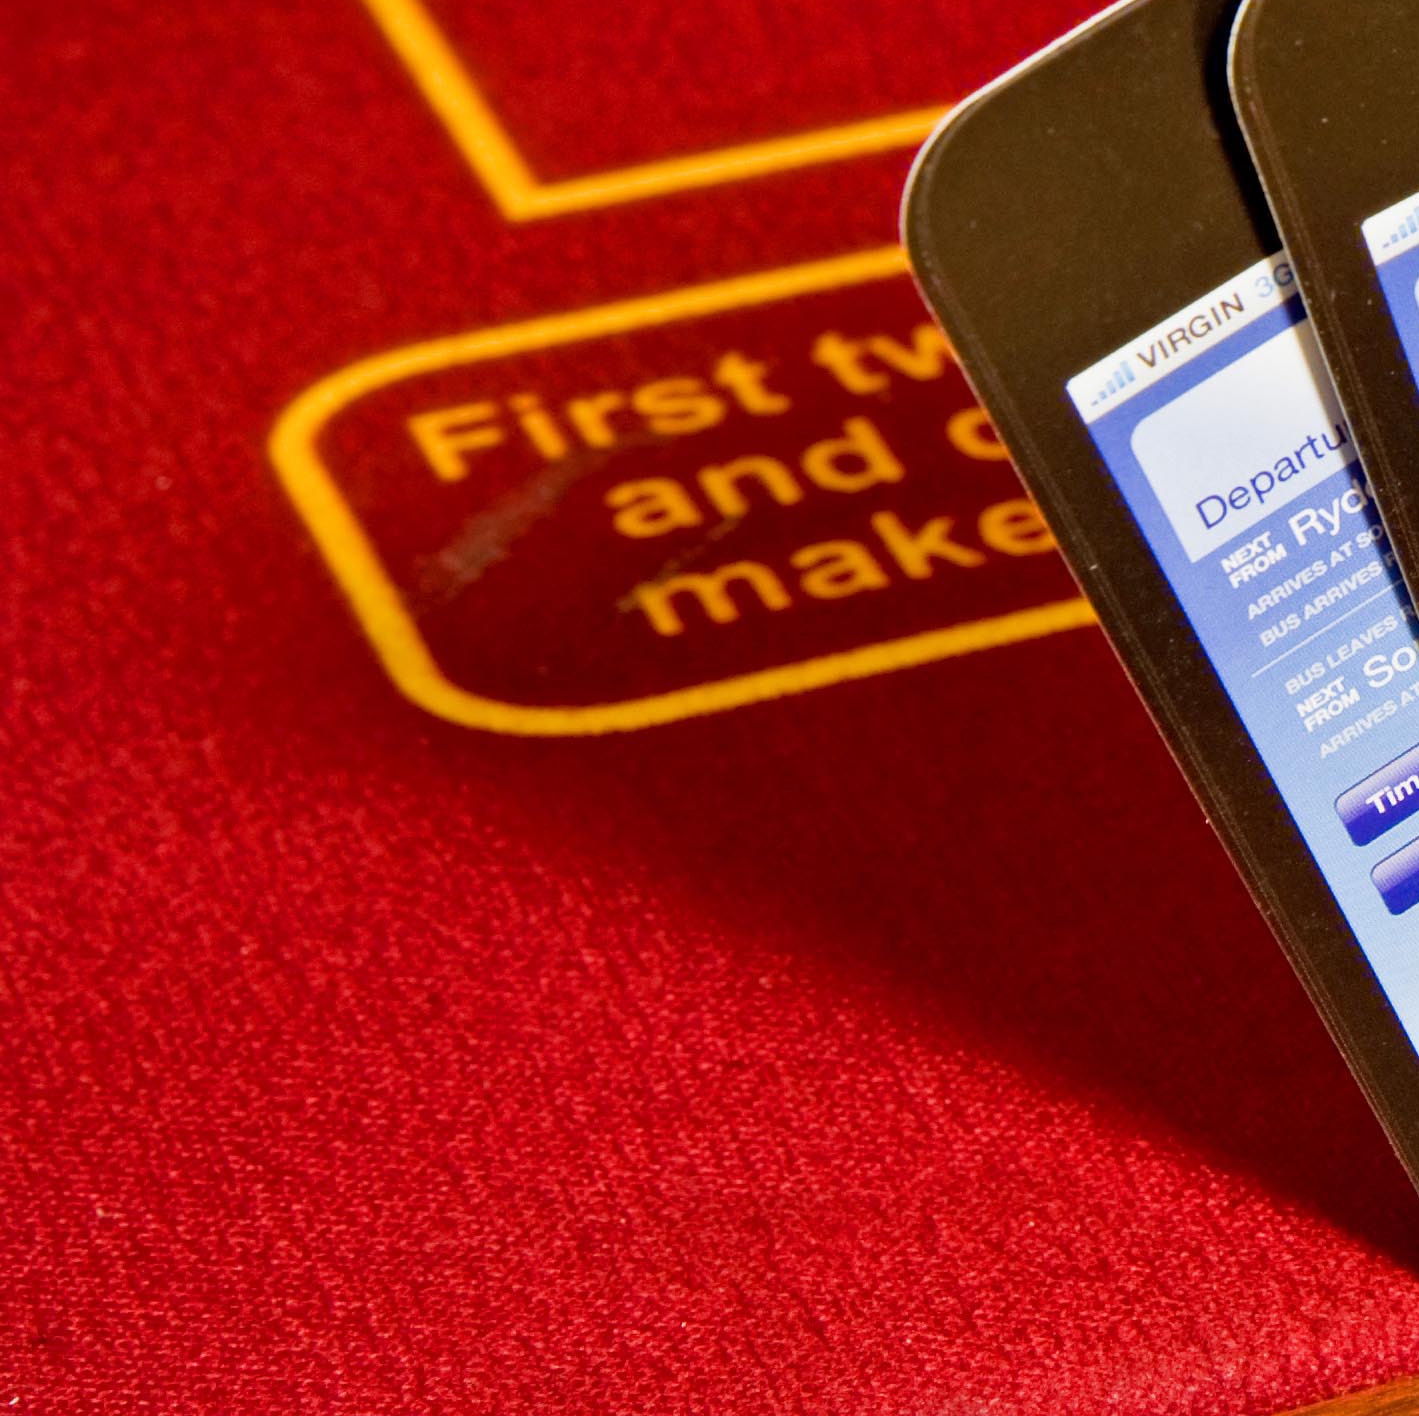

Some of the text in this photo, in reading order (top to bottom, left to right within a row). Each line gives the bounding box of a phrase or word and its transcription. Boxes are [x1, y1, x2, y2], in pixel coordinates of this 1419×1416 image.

[1137, 263, 1295, 369] VIRGIN 3G
[407, 350, 790, 482] First
[606, 417, 905, 539] and
[628, 496, 1059, 638] make
[1220, 530, 1271, 573] NEXT
[1228, 543, 1287, 589] FROM
[1248, 560, 1328, 620] ARRIVES
[1330, 540, 1353, 568] AT
[1259, 613, 1301, 648] BUS
[1304, 560, 1383, 620] ARRIVES
[1285, 662, 1326, 695] BUS
[1326, 615, 1398, 669] LEAVES
[1296, 675, 1345, 717] NEXT
[1303, 687, 1361, 733] FROM
[1320, 699, 1398, 760] ARRIVES
